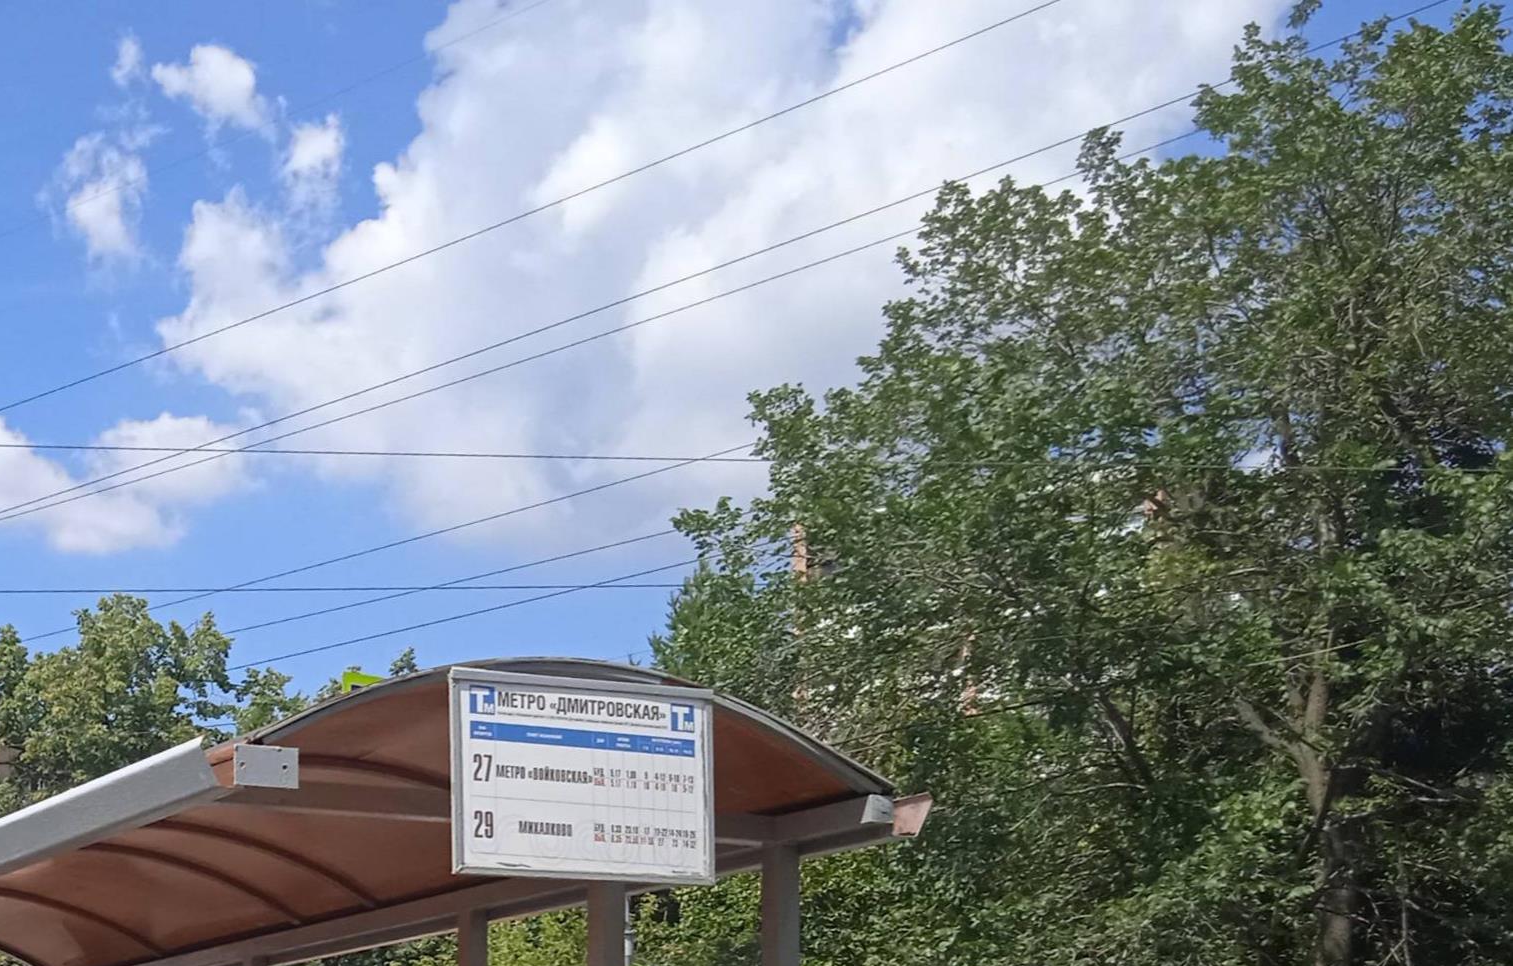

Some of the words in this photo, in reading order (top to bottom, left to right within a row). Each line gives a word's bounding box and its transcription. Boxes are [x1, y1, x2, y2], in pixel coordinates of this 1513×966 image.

[497, 691, 546, 711] МЕТРО
[550, 696, 666, 721] «ДМИТРОВСКАЯ»
[472, 753, 492, 782] 27
[496, 764, 526, 780] МЕТРО
[473, 810, 494, 838] 29
